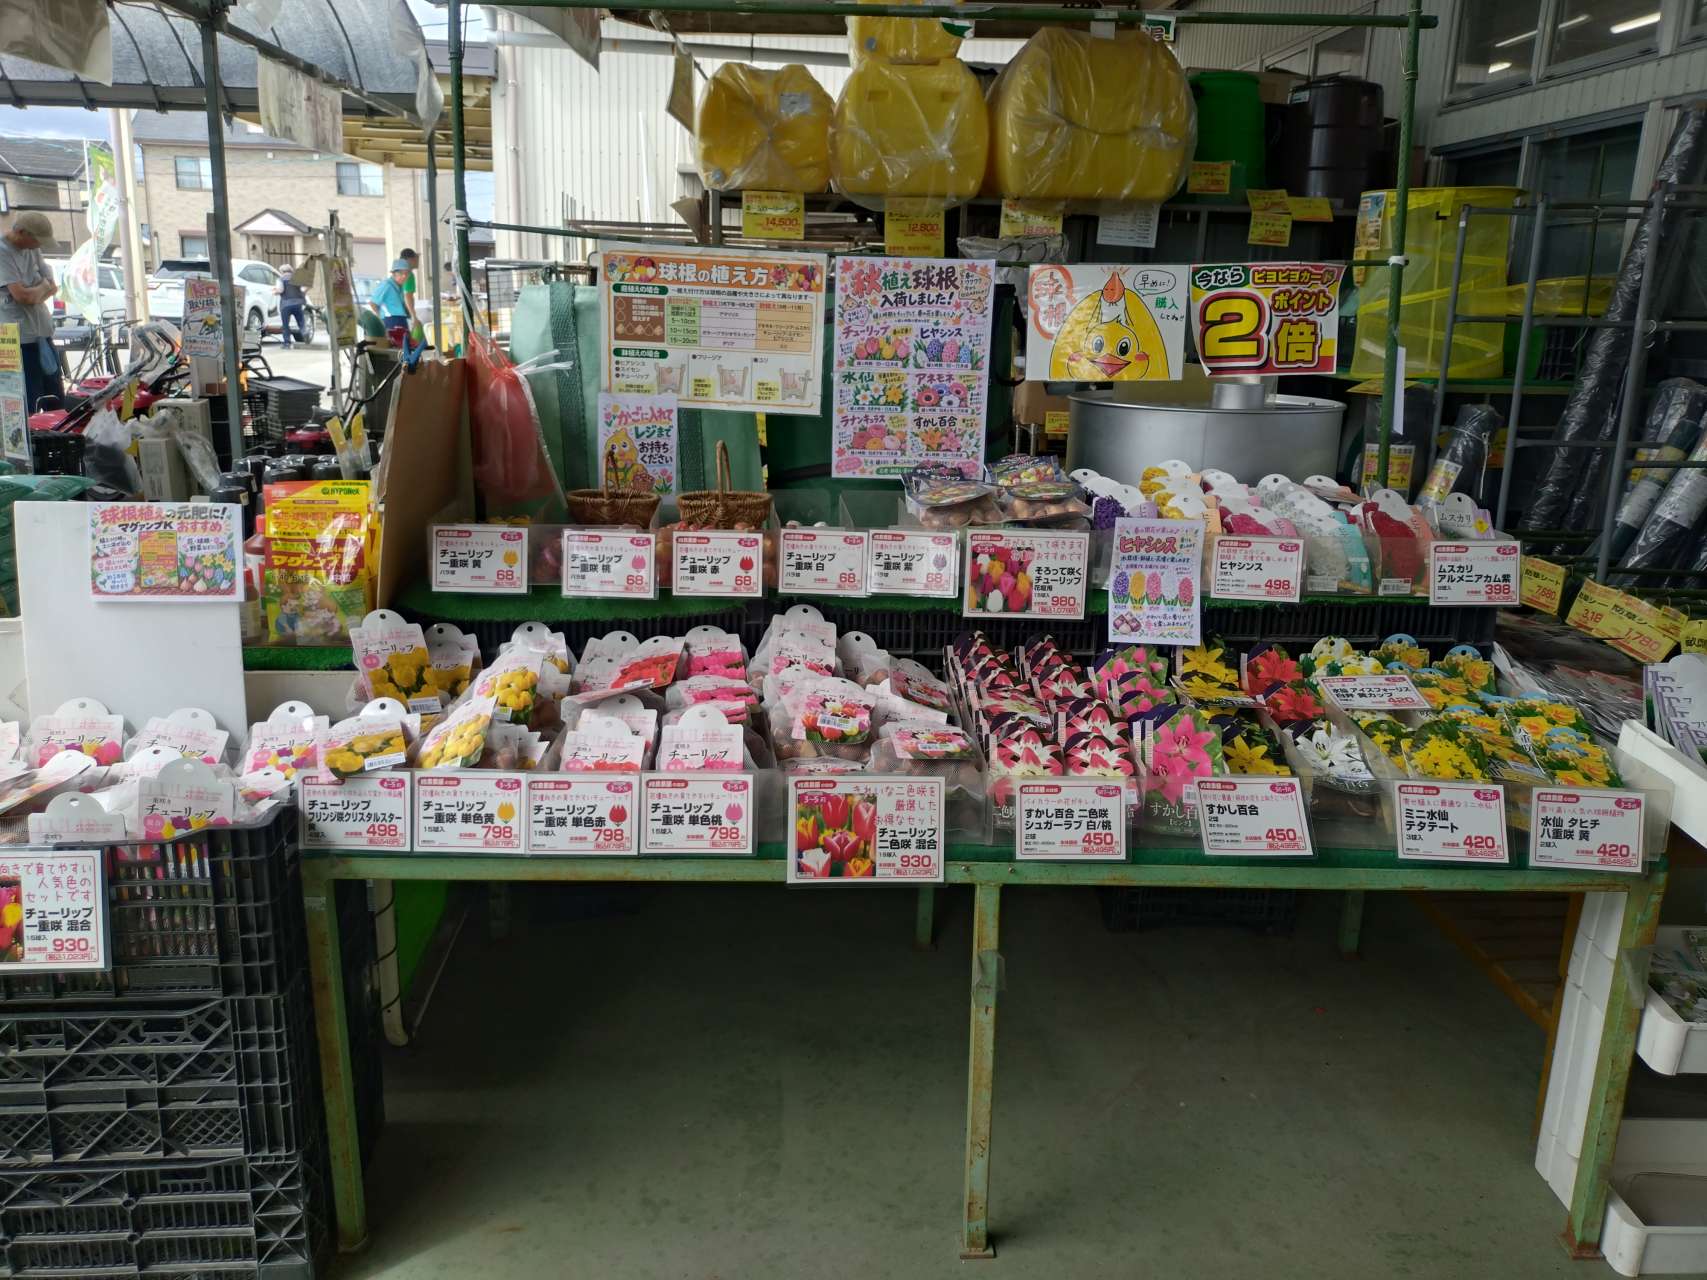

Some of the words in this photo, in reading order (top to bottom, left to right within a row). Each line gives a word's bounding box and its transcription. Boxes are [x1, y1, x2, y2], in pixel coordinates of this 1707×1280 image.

[658, 262, 769, 286] 球根の植え方
[1196, 271, 1245, 288] 今なら
[852, 263, 960, 299] 秋植え球根
[880, 291, 954, 308] 入荷しました!
[1272, 290, 1334, 315] ポイント
[842, 325, 890, 338] チューリップ
[920, 327, 963, 338] ヒヤシンス
[1204, 296, 1260, 358] 2
[1276, 321, 1317, 364] 倍
[842, 372, 874, 385] 水仙
[916, 373, 954, 385] アネモネ
[618, 406, 674, 425] かごに入れて
[914, 416, 958, 429] すかし百合
[634, 425, 674, 439] レジまで
[638, 441, 670, 454] お持ち
[640, 454, 673, 464] ください
[100, 506, 228, 525] 球根植えの元肥に!
[1440, 512, 1471, 522] ムスカリ
[118, 521, 174, 532] マグァンプK
[176, 520, 222, 532] おすすめ
[1120, 536, 1178, 554] ヒヤシンス
[440, 549, 494, 560] チューリップ
[570, 554, 623, 564] チューリップ
[680, 554, 730, 565] チューリップ
[786, 552, 836, 562] チューリップ
[874, 552, 924, 562] チューリップ
[440, 560, 470, 568] 一重咲
[472, 560, 482, 568] 黄
[570, 564, 600, 573] 一重咲
[602, 564, 612, 574] 桃
[680, 565, 708, 574] 一重咲
[710, 566, 720, 574] 赤
[786, 562, 812, 571] 一重咲
[816, 562, 824, 572] 白
[874, 562, 902, 571] 一重咲
[904, 562, 914, 572] 紫
[1220, 561, 1263, 571] ヒヤシンス
[1438, 564, 1473, 574] ムスカリ
[496, 570, 514, 580] 68
[1034, 566, 1082, 576] そろって咲く
[1525, 568, 1561, 586] 防草シート
[626, 574, 644, 586] 68
[734, 575, 752, 586] 68
[839, 572, 856, 584] 68
[926, 572, 944, 584] 68
[1034, 576, 1082, 584] チューリップ
[1438, 574, 1512, 584] アルメニアカム紫
[1034, 584, 1053, 592] 花壇用
[1265, 579, 1290, 590] 498
[1484, 584, 1511, 594] 398
[1051, 596, 1076, 606] 980
[1624, 628, 1662, 652] 1,780
[361, 644, 416, 656] チューリップ
[42, 734, 106, 745] チューリップ
[257, 738, 314, 750] チューリップ
[569, 750, 628, 762] チューリップ
[668, 748, 729, 760] チューリップ
[853, 784, 936, 798] きれいな二色咲を
[145, 804, 216, 818] チューリップ
[308, 800, 372, 810] チューリップ
[422, 801, 486, 812] チューリップ
[534, 804, 597, 815] チューリップ
[650, 802, 714, 813] チューリップ
[894, 800, 936, 812] 厳選した
[1206, 804, 1259, 816] すかし百合
[308, 812, 402, 822] フリンジ咲クリスタルスター
[422, 814, 457, 824] 一重咲
[461, 814, 496, 824] 単色黄
[1024, 808, 1074, 818] すかし百合
[1078, 808, 1109, 818] 二色咲
[1405, 808, 1449, 821] ミニ水仙
[533, 816, 568, 828] 一重咲
[572, 816, 606, 828] 単色赤
[650, 814, 684, 826] 一重咲
[688, 815, 722, 826] 単色桃
[874, 814, 937, 826] お得なセット
[1024, 820, 1082, 830] シュガーラブ
[1086, 820, 1112, 830] 白/桃
[1540, 816, 1564, 828] 水仙
[1568, 817, 1600, 829] タヒチ
[367, 824, 398, 837] 498
[482, 826, 513, 839] 798
[1406, 820, 1459, 833] テタテート
[592, 828, 624, 842] 798
[708, 826, 740, 840] 798
[878, 828, 938, 838] チューリップ
[1082, 832, 1114, 846] 450
[1266, 828, 1297, 841] 450
[1540, 828, 1574, 840] 八重咲
[1578, 830, 1590, 842] 黄
[878, 839, 912, 850] 二色咲
[915, 839, 938, 850] 混合
[1463, 835, 1496, 848] 420
[1597, 843, 1630, 858] 420
[900, 854, 932, 868] 930
[38, 876, 91, 890] 人気色の
[26, 891, 91, 904] セットです
[25, 907, 94, 920] チューリップ
[26, 920, 62, 932] 一重咲
[66, 920, 92, 932] 混合
[52, 938, 88, 952] 930
